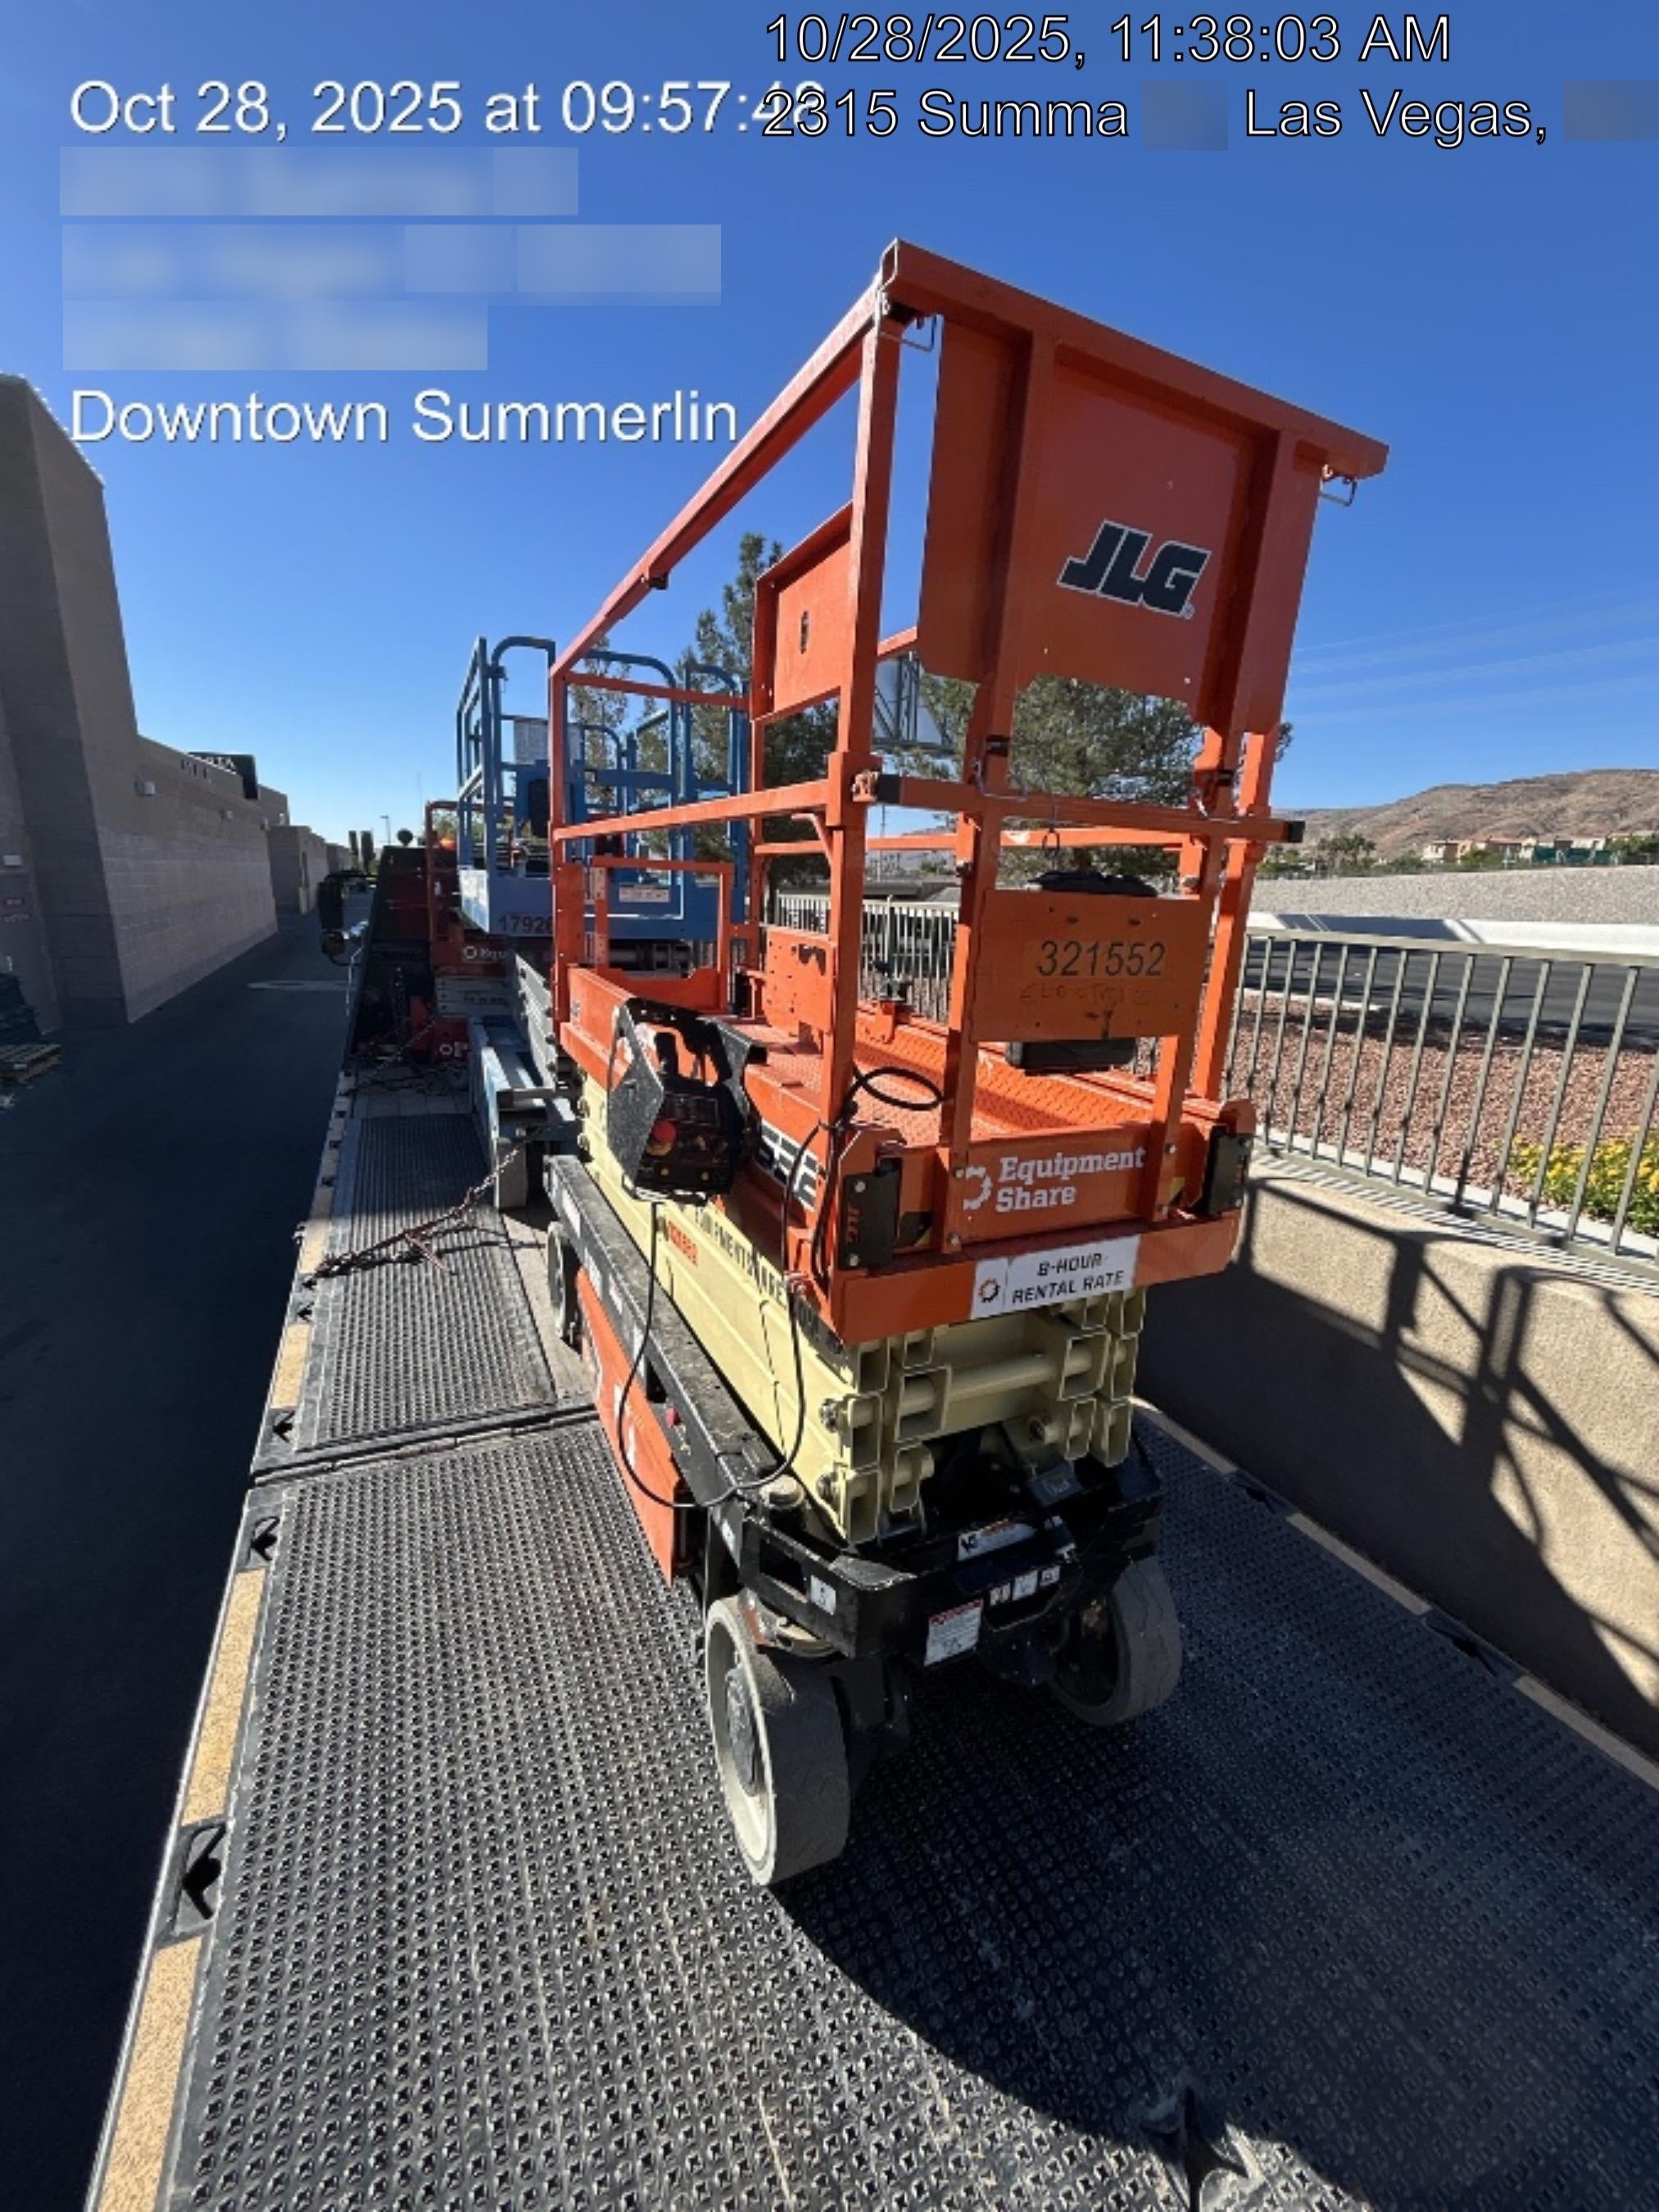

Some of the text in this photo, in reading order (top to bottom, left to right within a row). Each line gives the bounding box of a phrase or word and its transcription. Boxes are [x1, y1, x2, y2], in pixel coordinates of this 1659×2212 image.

[1057, 518, 1213, 618] JLG
[1036, 941, 1167, 977] 321552
[998, 1147, 1146, 1185] Equipment
[995, 1186, 1077, 1213] Share
[1011, 1271, 1125, 1304] RENTAL RATE
